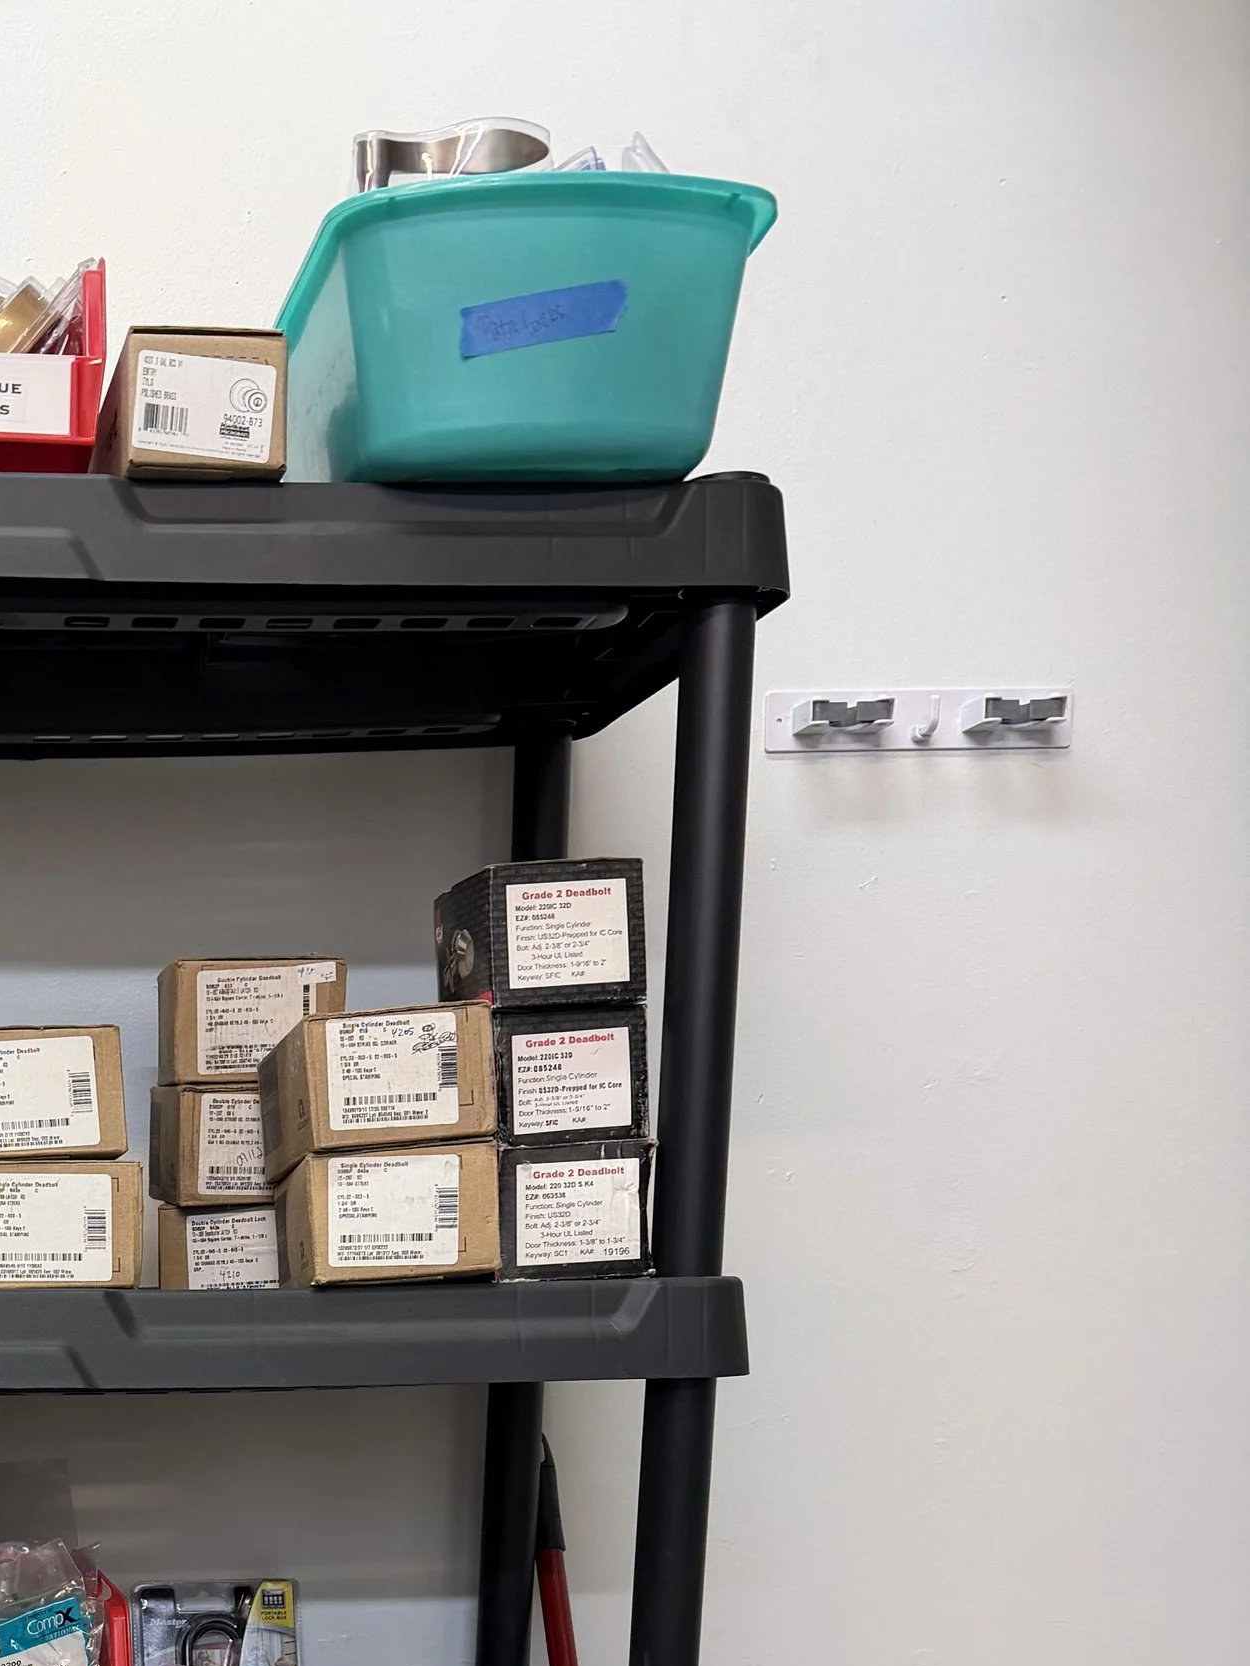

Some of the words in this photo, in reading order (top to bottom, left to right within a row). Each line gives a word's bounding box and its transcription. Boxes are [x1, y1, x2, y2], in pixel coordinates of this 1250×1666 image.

[224, 414, 263, 427] 94002-873
[522, 892, 553, 900] Grade
[556, 890, 562, 898] 2
[566, 888, 611, 897] Deadbolt
[392, 1027, 414, 1036] 4205
[526, 1039, 556, 1047] Grade
[559, 1037, 565, 1045] 2
[569, 1033, 614, 1044] Deadbolt
[534, 1064, 562, 1072] 085248
[533, 1170, 564, 1179] Grade
[568, 1169, 574, 1177] 2
[578, 1167, 624, 1176] Deadbolt
[577, 1200, 603, 1208] Cylinder
[604, 1247, 630, 1256] 19196
[219, 1270, 240, 1282] 4210
[27, 1606, 79, 1635] CompX
